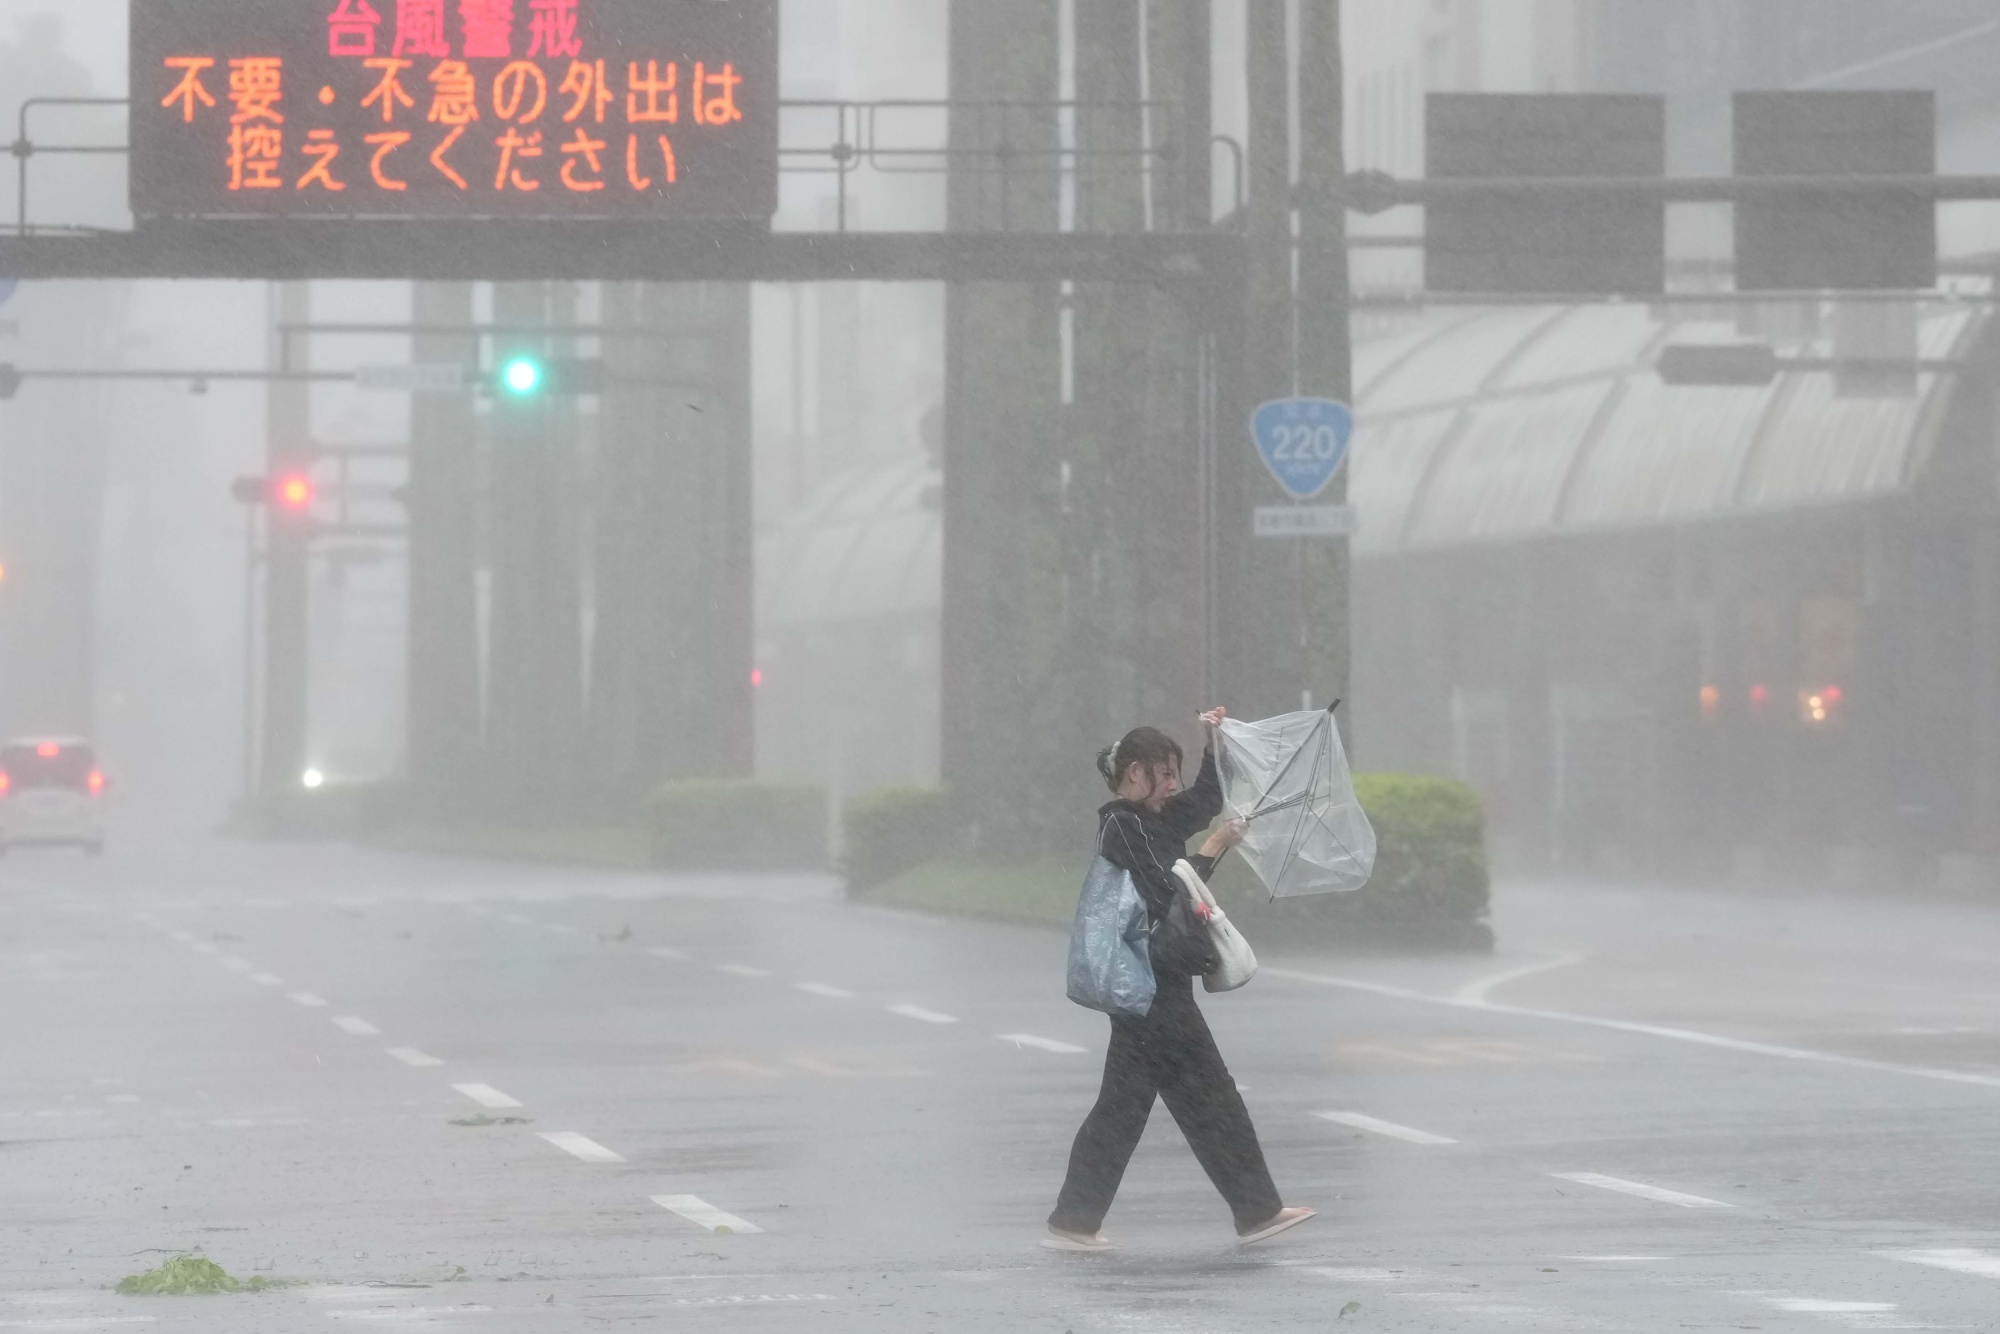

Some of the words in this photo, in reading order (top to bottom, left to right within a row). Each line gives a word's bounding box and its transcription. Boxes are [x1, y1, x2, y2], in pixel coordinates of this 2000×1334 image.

[327, 0, 583, 57] 台風警戒
[161, 57, 742, 125] 不要・不急の外出は
[226, 126, 676, 191] 控えてください
[1272, 425, 1337, 460] 220
